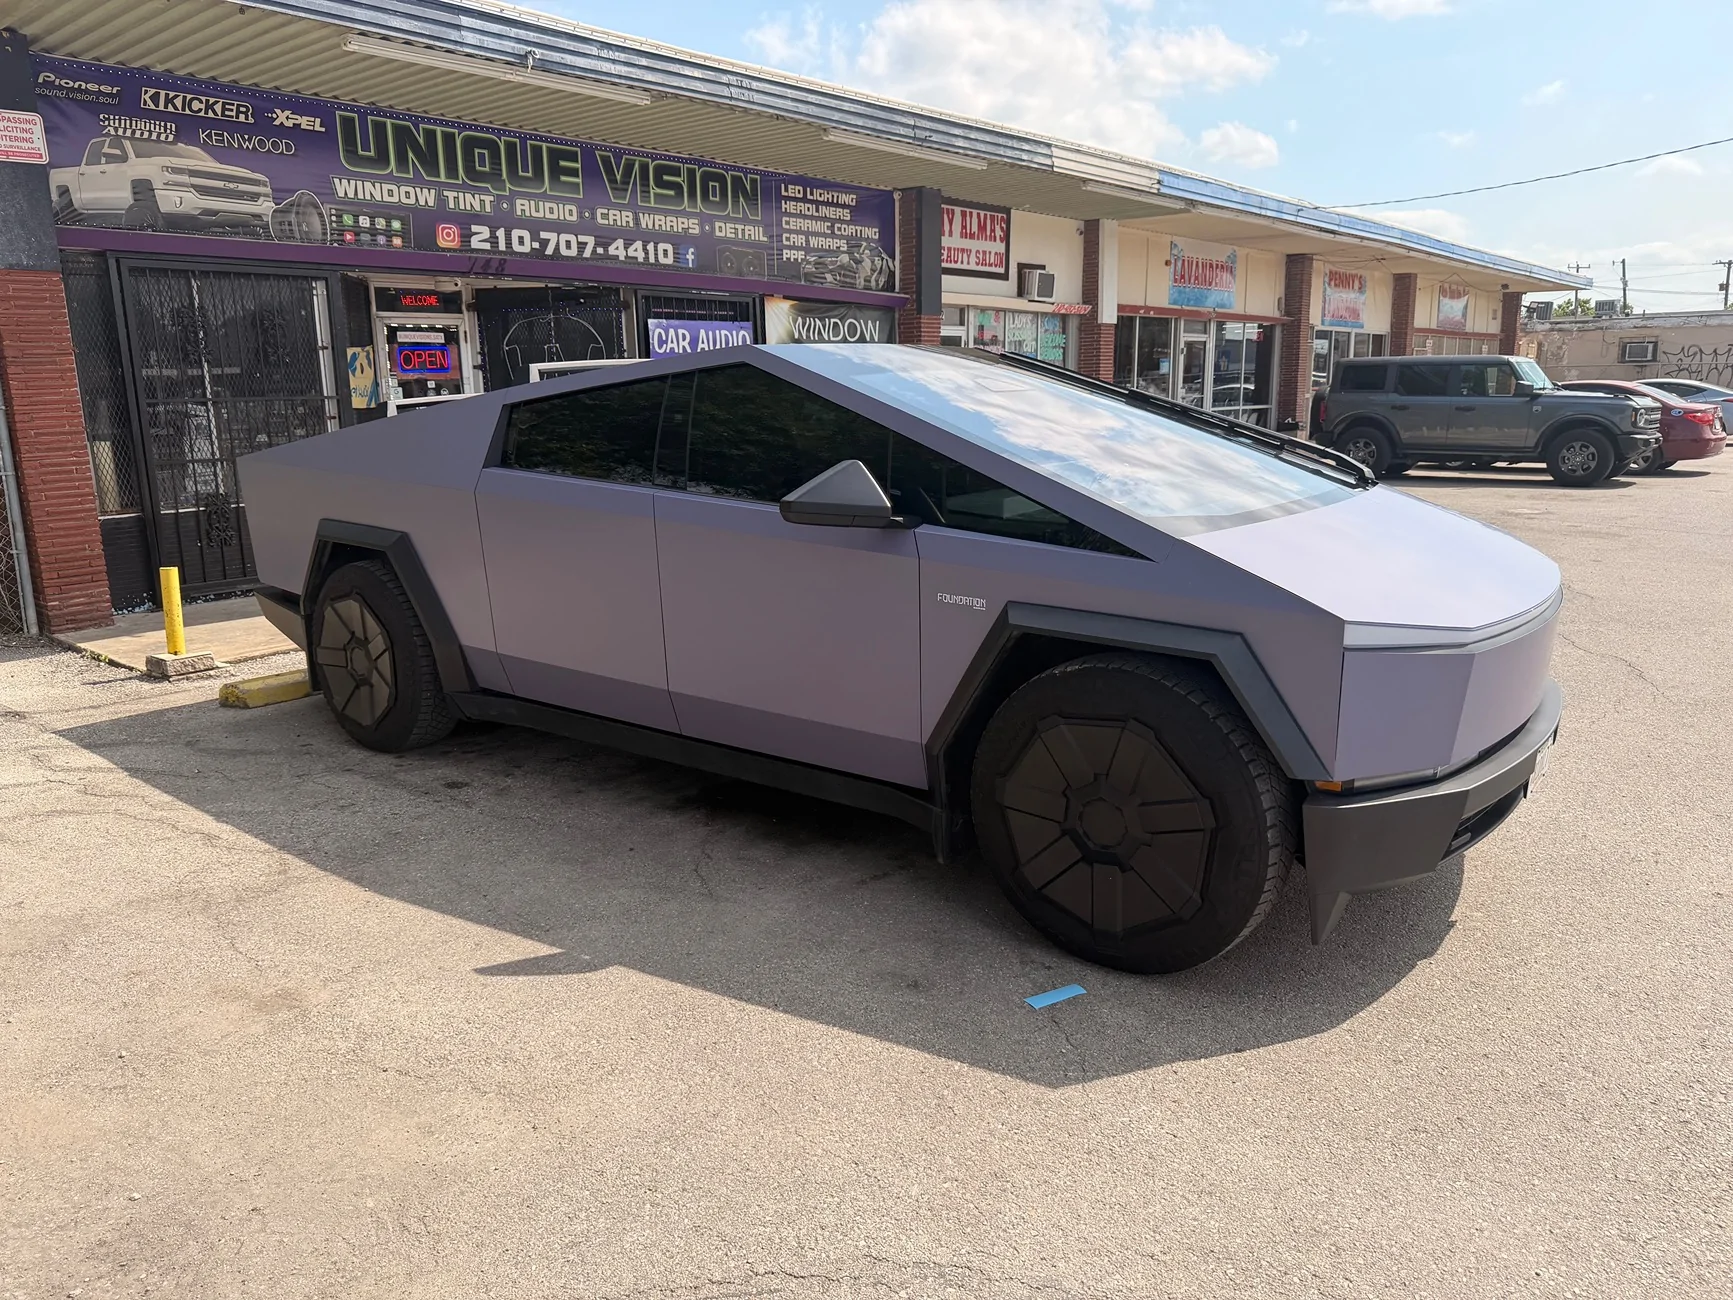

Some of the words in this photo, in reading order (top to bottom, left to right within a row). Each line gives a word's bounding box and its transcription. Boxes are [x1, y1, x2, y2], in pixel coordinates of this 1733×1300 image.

[38, 72, 121, 94] Pioneer
[34, 87, 119, 105] sound.vision.soul
[163, 92, 252, 121] KICKER
[0, 115, 38, 126] PASSING
[272, 108, 326, 132] XPEL
[101, 126, 175, 142] AUDIO
[199, 128, 295, 155] KENWOOD
[336, 111, 583, 198] UNIQUE
[595, 150, 762, 221] VISION
[781, 183, 804, 198] LED
[806, 187, 857, 206] LIGHTING
[331, 176, 438, 209] WINDOW
[442, 189, 495, 213] TINT
[514, 198, 579, 222] AUDIO
[595, 207, 634, 228] CAR
[638, 211, 700, 235] WRAPS
[714, 220, 768, 242] DETAIL
[781, 200, 851, 220] HEADLINERS
[782, 216, 832, 233] CERAMIC
[834, 223, 879, 239] COATING
[960, 209, 1007, 243] ALMA'S
[470, 224, 674, 265] 210-707-4410
[782, 233, 806, 247] CAR
[808, 235, 848, 251] WRAPS
[782, 248, 805, 262] PPF
[941, 246, 972, 265] EAUTY
[975, 249, 1005, 268] SALON
[1172, 255, 1234, 292] LAVANDERIA
[1328, 269, 1363, 292] PENNY'S
[400, 295, 440, 306] WELCOME
[789, 315, 880, 342] WINDOW
[653, 328, 691, 354] CAR
[696, 328, 751, 352] AUDIO
[400, 350, 449, 369] OPEN
[937, 592, 987, 608] FOUNDATION
